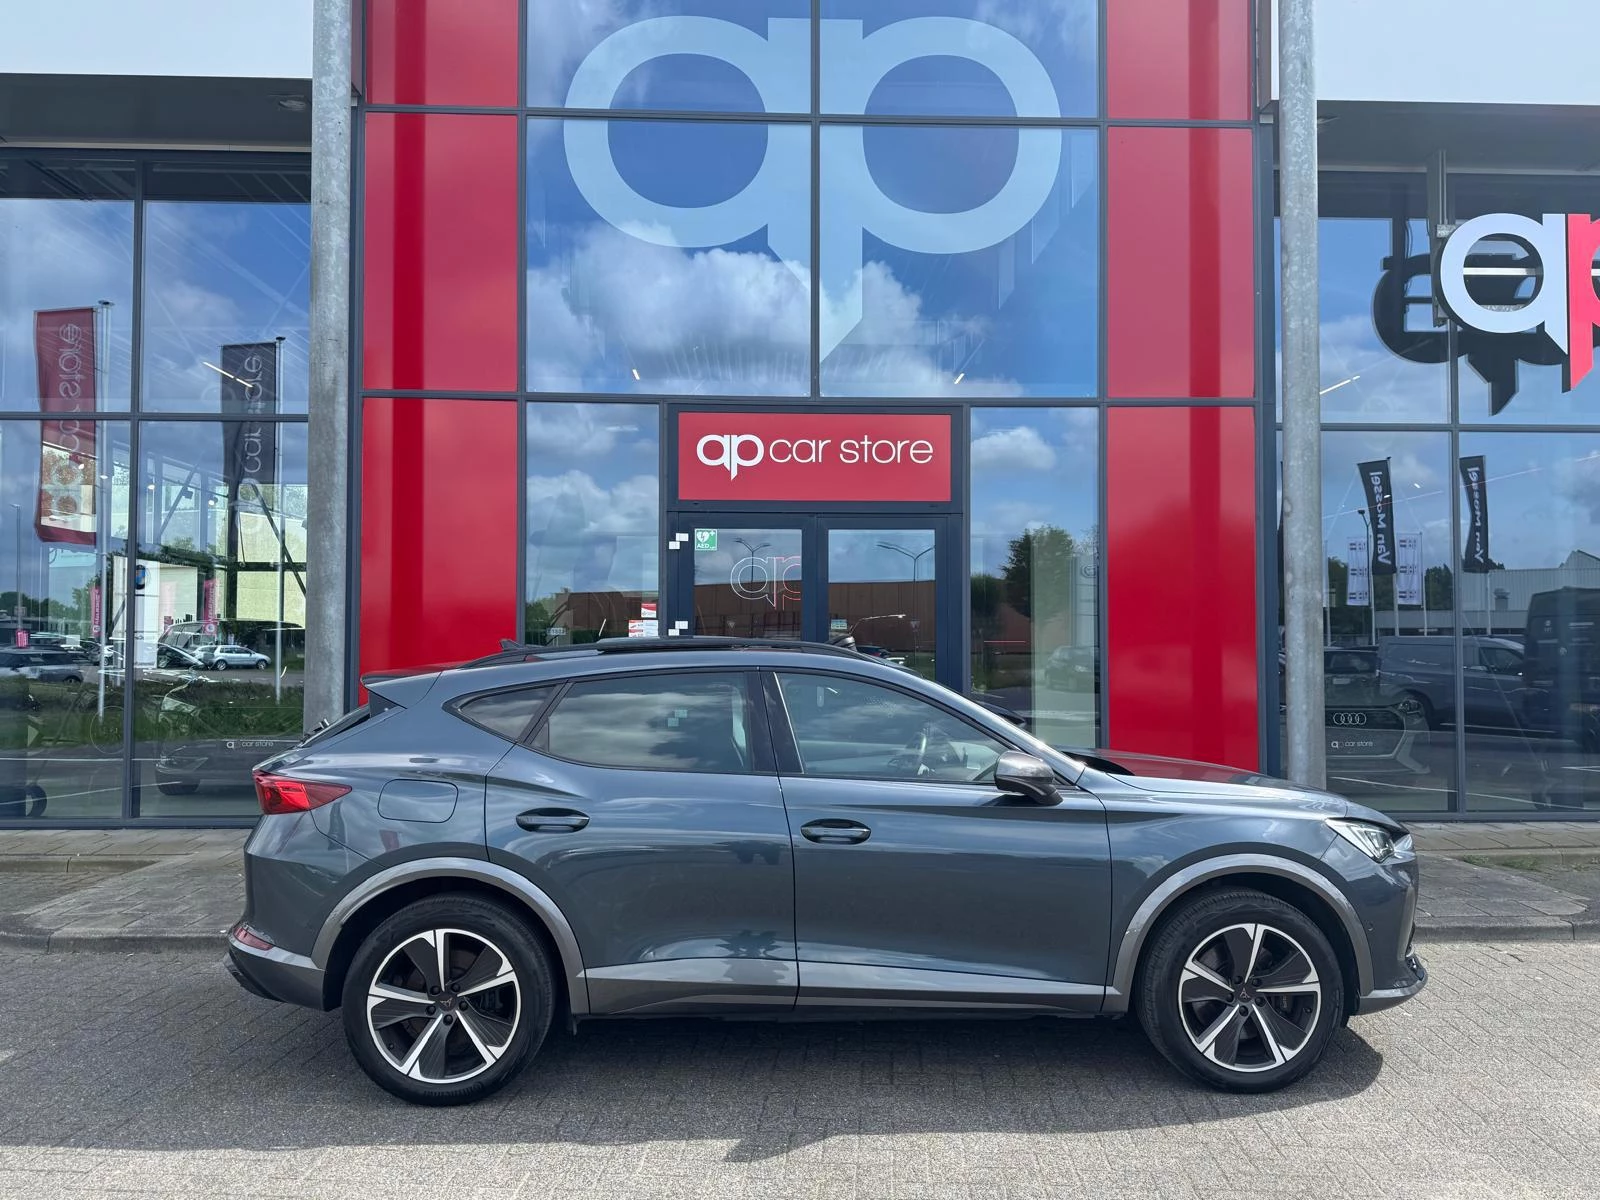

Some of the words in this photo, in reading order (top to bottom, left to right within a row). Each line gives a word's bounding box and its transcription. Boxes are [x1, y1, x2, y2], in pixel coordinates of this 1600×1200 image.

[563, 15, 1062, 364] ap
[1441, 213, 1600, 390] a
[696, 434, 764, 481] ap
[769, 438, 831, 463] car
[839, 434, 934, 464] store
